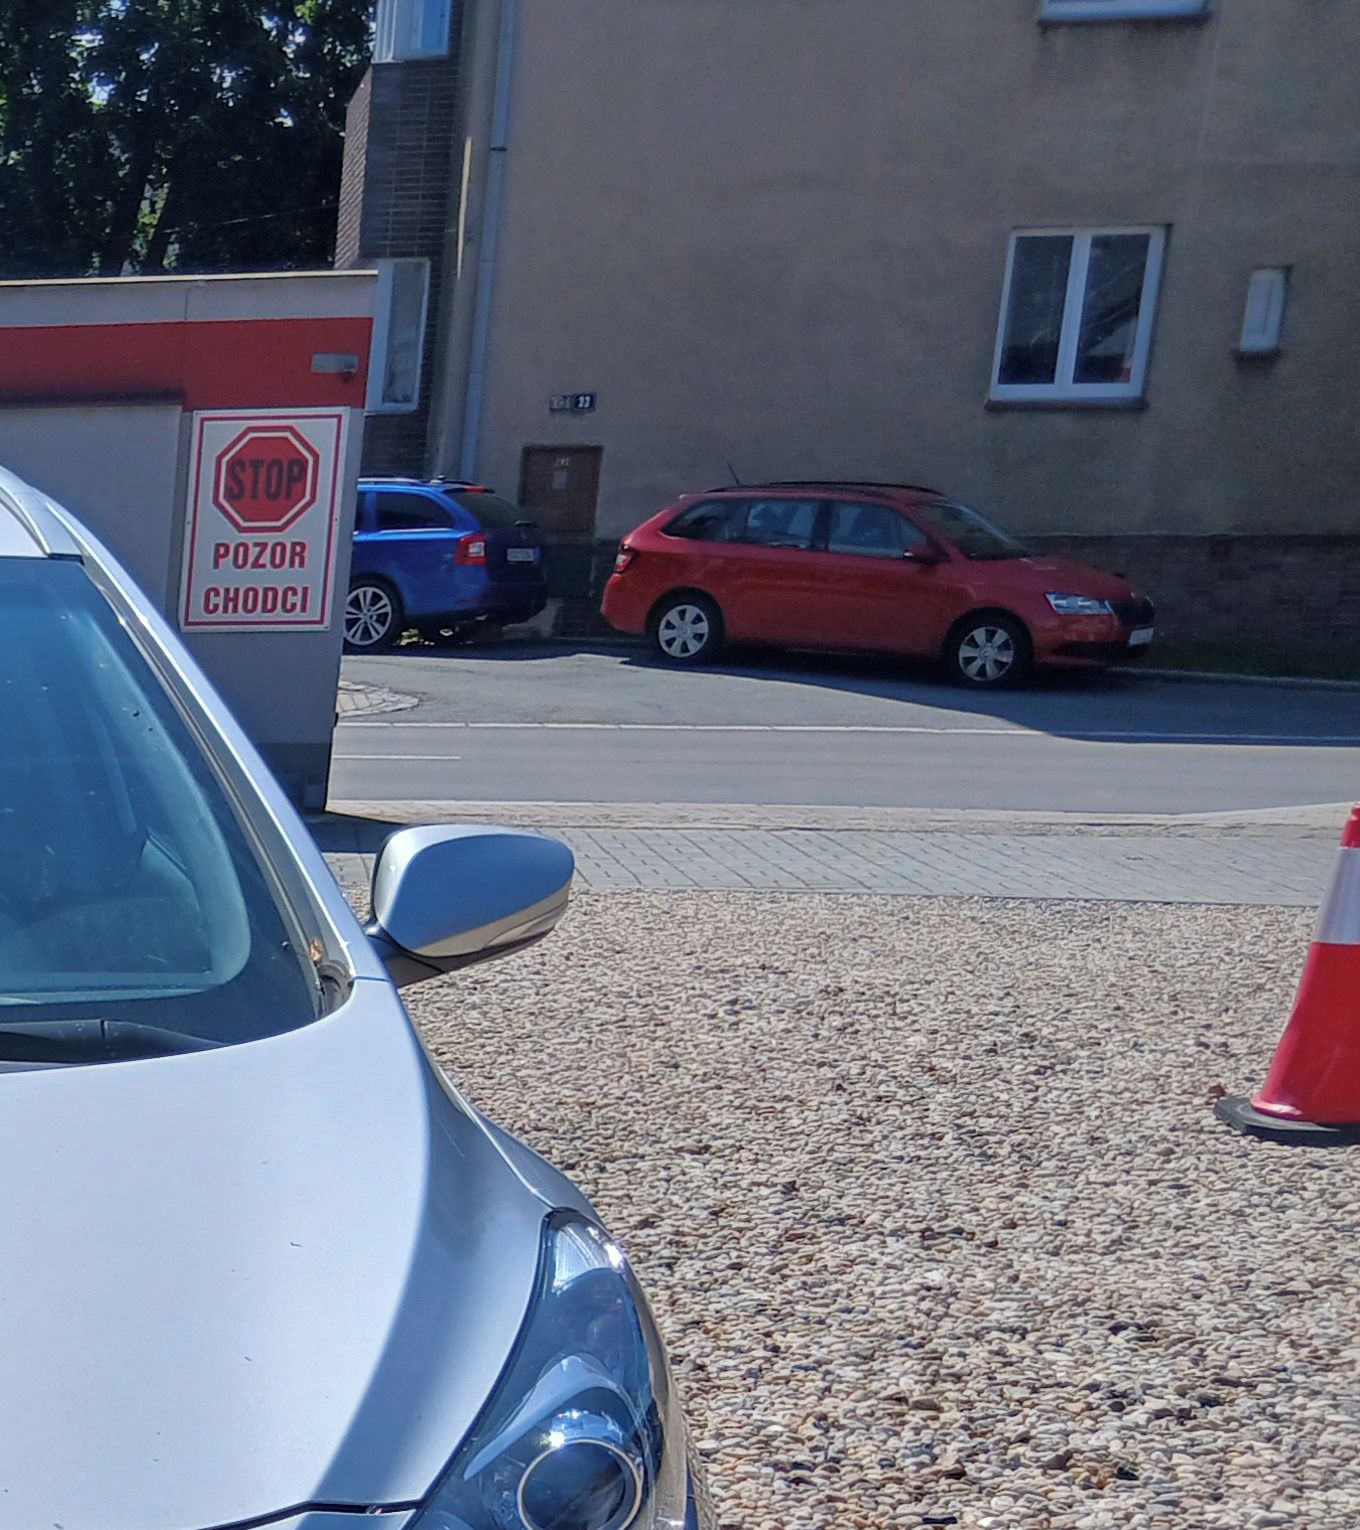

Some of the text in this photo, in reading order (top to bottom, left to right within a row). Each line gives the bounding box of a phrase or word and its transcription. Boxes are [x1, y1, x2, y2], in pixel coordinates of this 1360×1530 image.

[227, 458, 306, 501] STOP
[212, 541, 307, 570] POZOR
[203, 586, 310, 615] CHODCI
